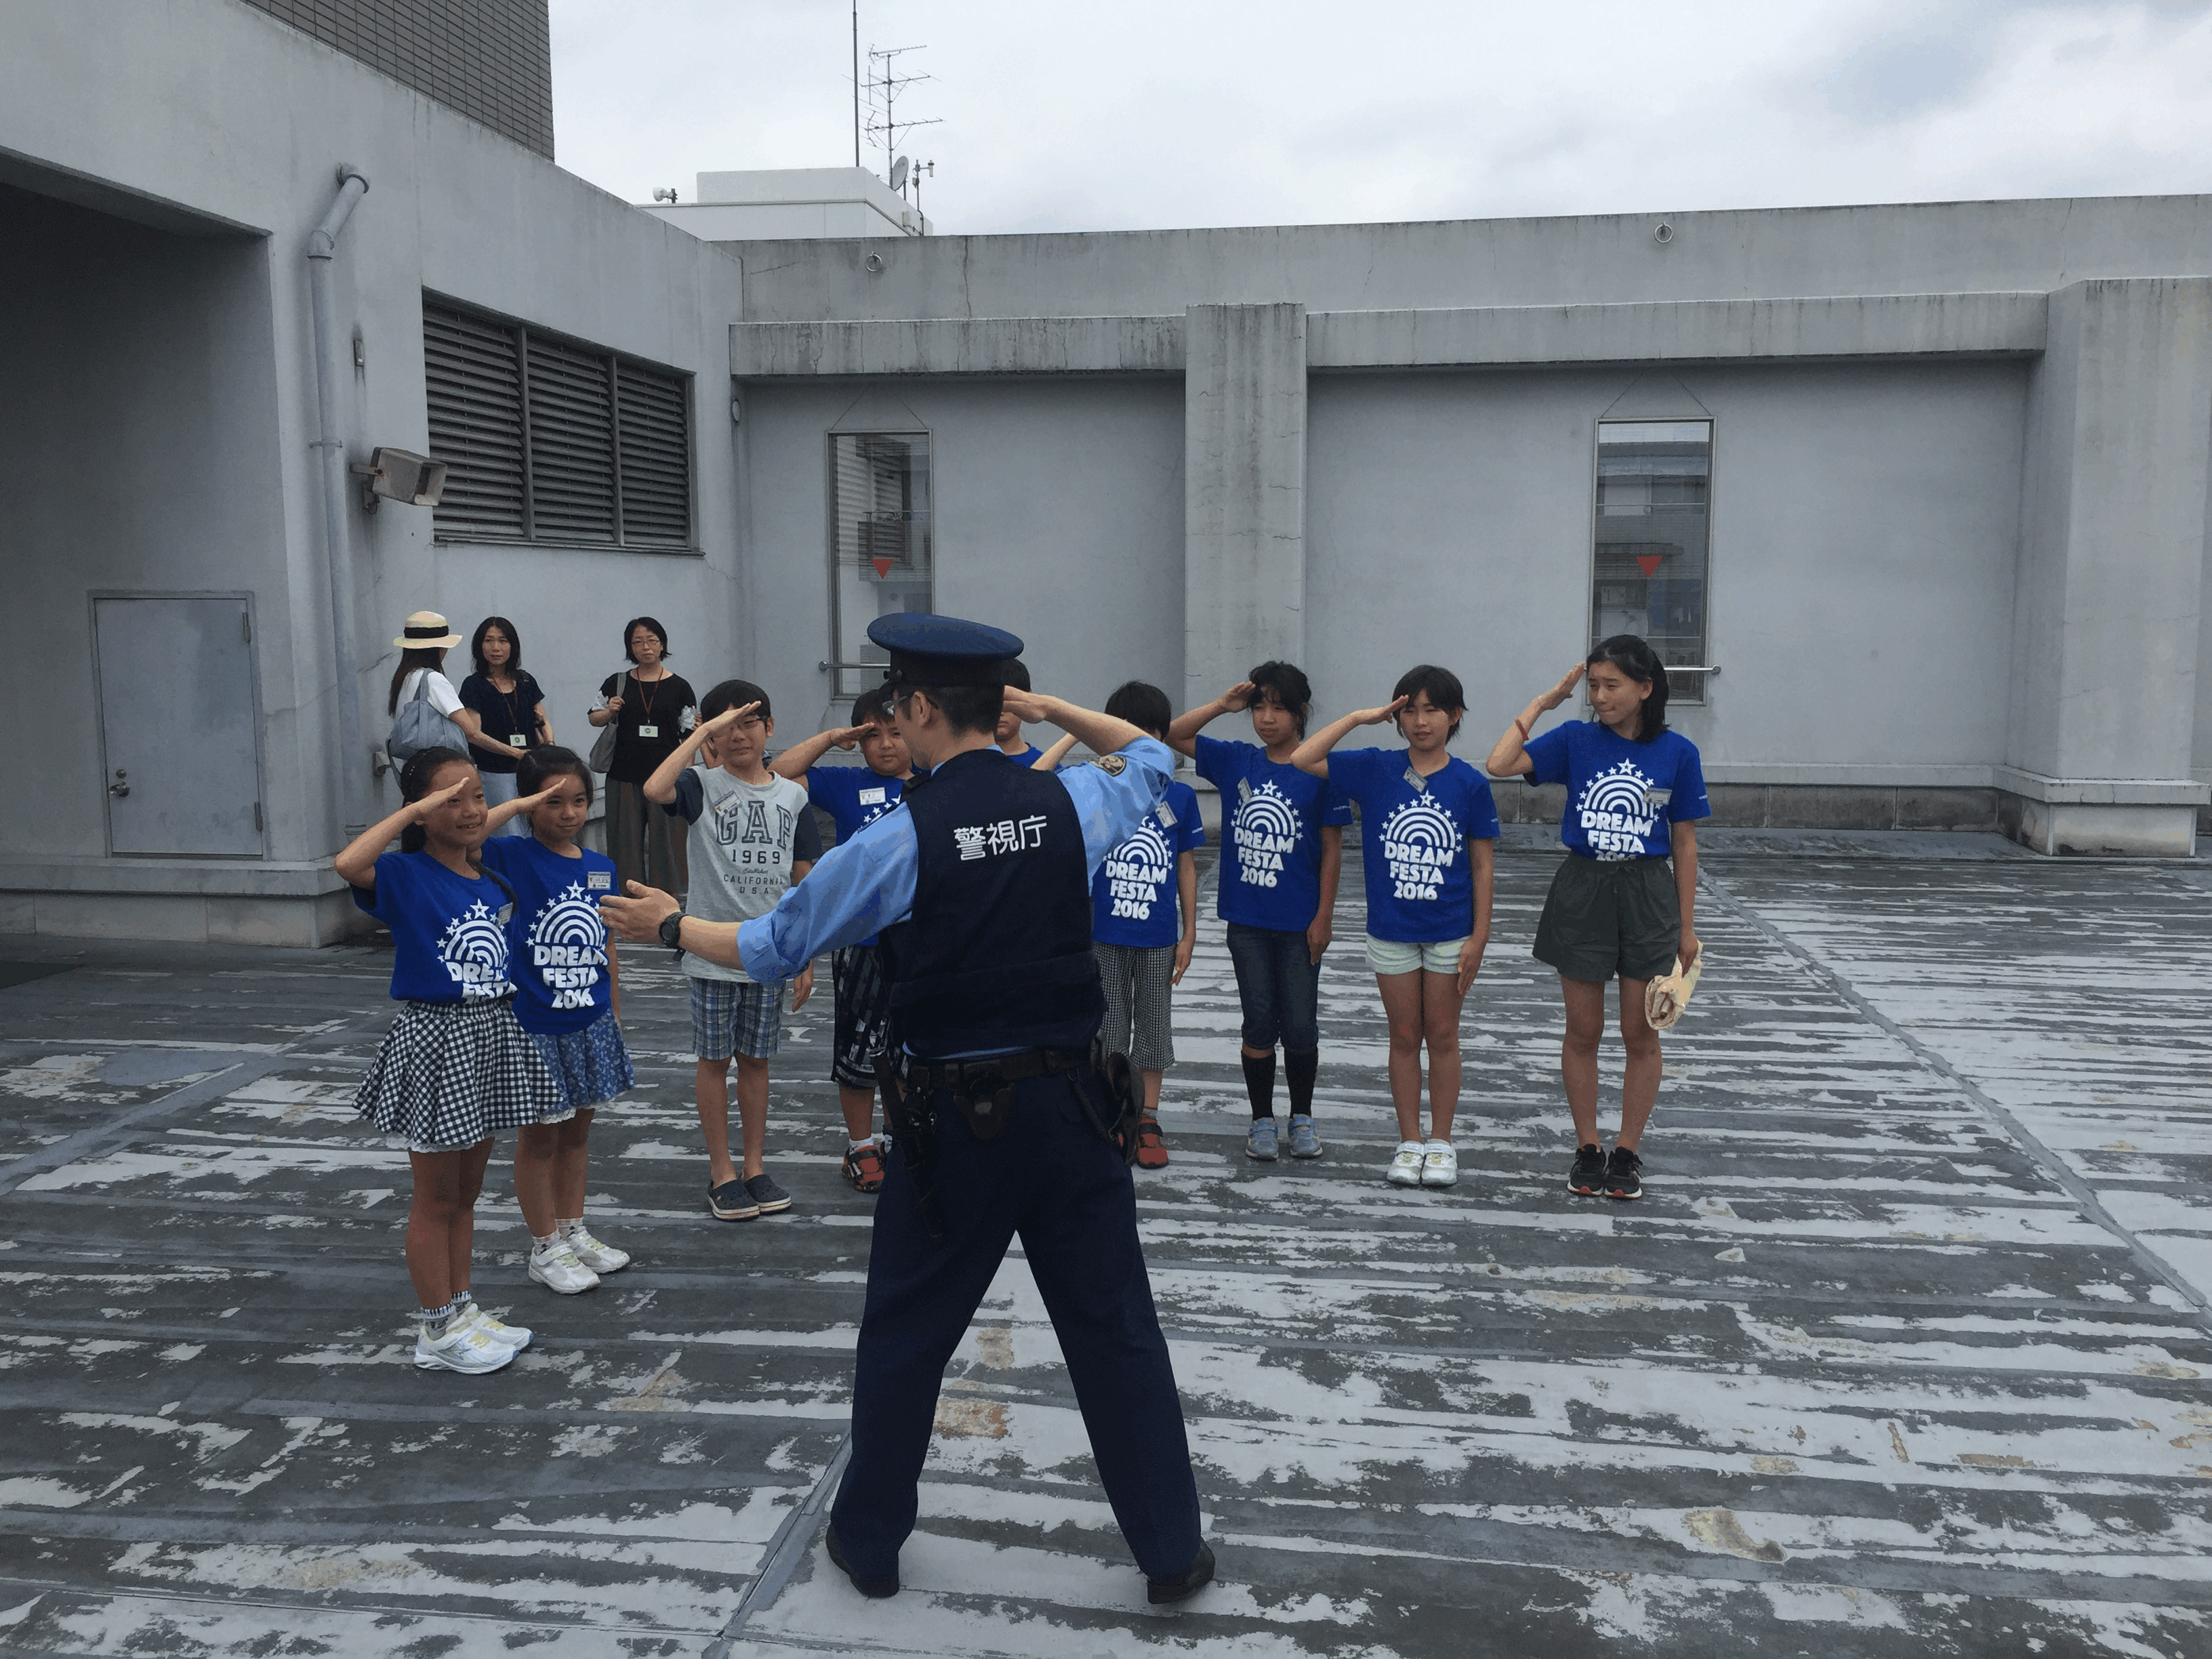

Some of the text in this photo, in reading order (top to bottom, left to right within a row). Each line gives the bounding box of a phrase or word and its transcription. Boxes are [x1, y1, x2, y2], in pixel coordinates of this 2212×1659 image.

[716, 801, 793, 851] GAP
[1581, 811, 1654, 837] DREAM
[954, 815, 1047, 861] 警視庁
[1234, 827, 1294, 854] DREAM
[1587, 830, 1645, 854] FESTA
[732, 849, 781, 864] 1969
[1237, 847, 1284, 871] FESTA
[1384, 840, 1454, 867] DREAM
[1105, 860, 1168, 884] DREAM
[1240, 865, 1277, 888] 2016
[1389, 861, 1445, 884] FESTA
[1109, 878, 1158, 902] FESTA
[1393, 881, 1438, 900] 2016
[1111, 898, 1150, 920] 2016
[533, 945, 609, 966] DREAM
[543, 966, 599, 988] FESTA
[550, 987, 595, 1009] 2016
